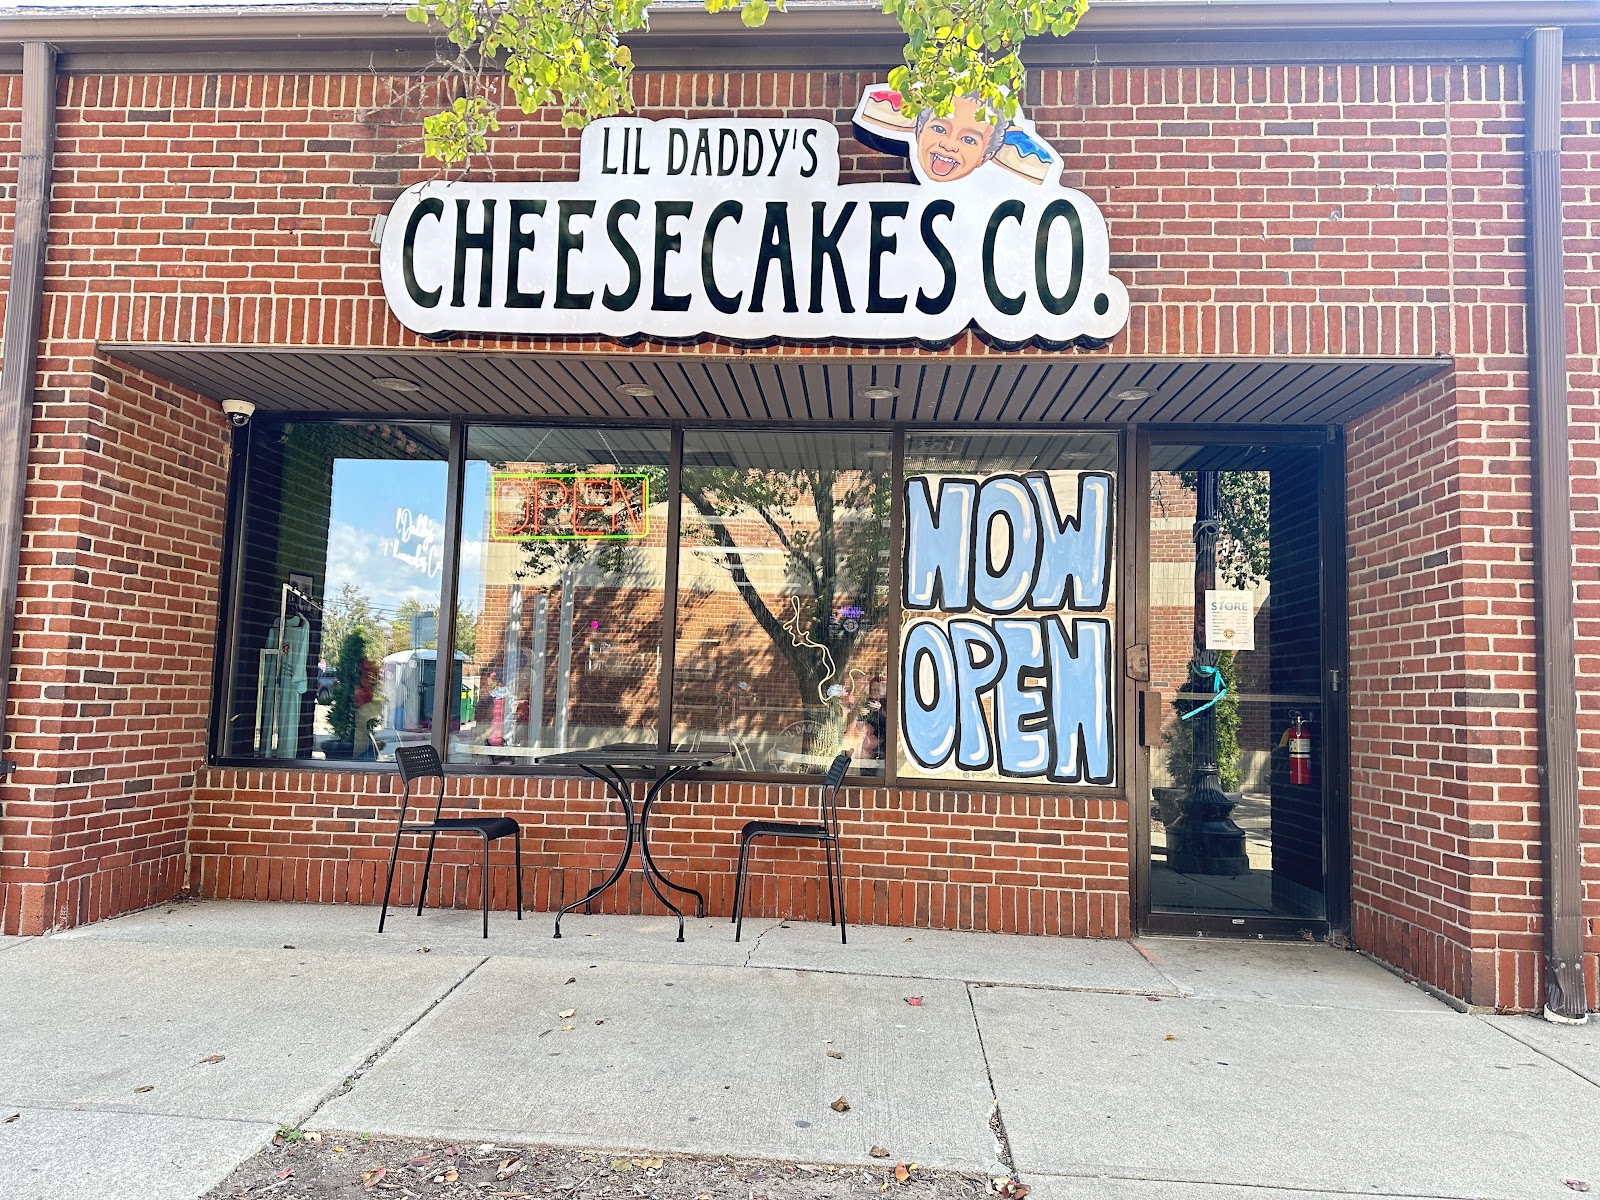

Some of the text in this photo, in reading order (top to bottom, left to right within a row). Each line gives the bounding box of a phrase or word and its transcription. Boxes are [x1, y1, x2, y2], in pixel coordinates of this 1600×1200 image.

[601, 127, 819, 178] LIL DADDY'S
[402, 198, 1110, 317] CHEESECAKES CO.
[495, 478, 647, 535] OPEN
[902, 471, 1114, 614] NOW
[1211, 601, 1249, 611] STORE
[901, 615, 1114, 784] OPEN
